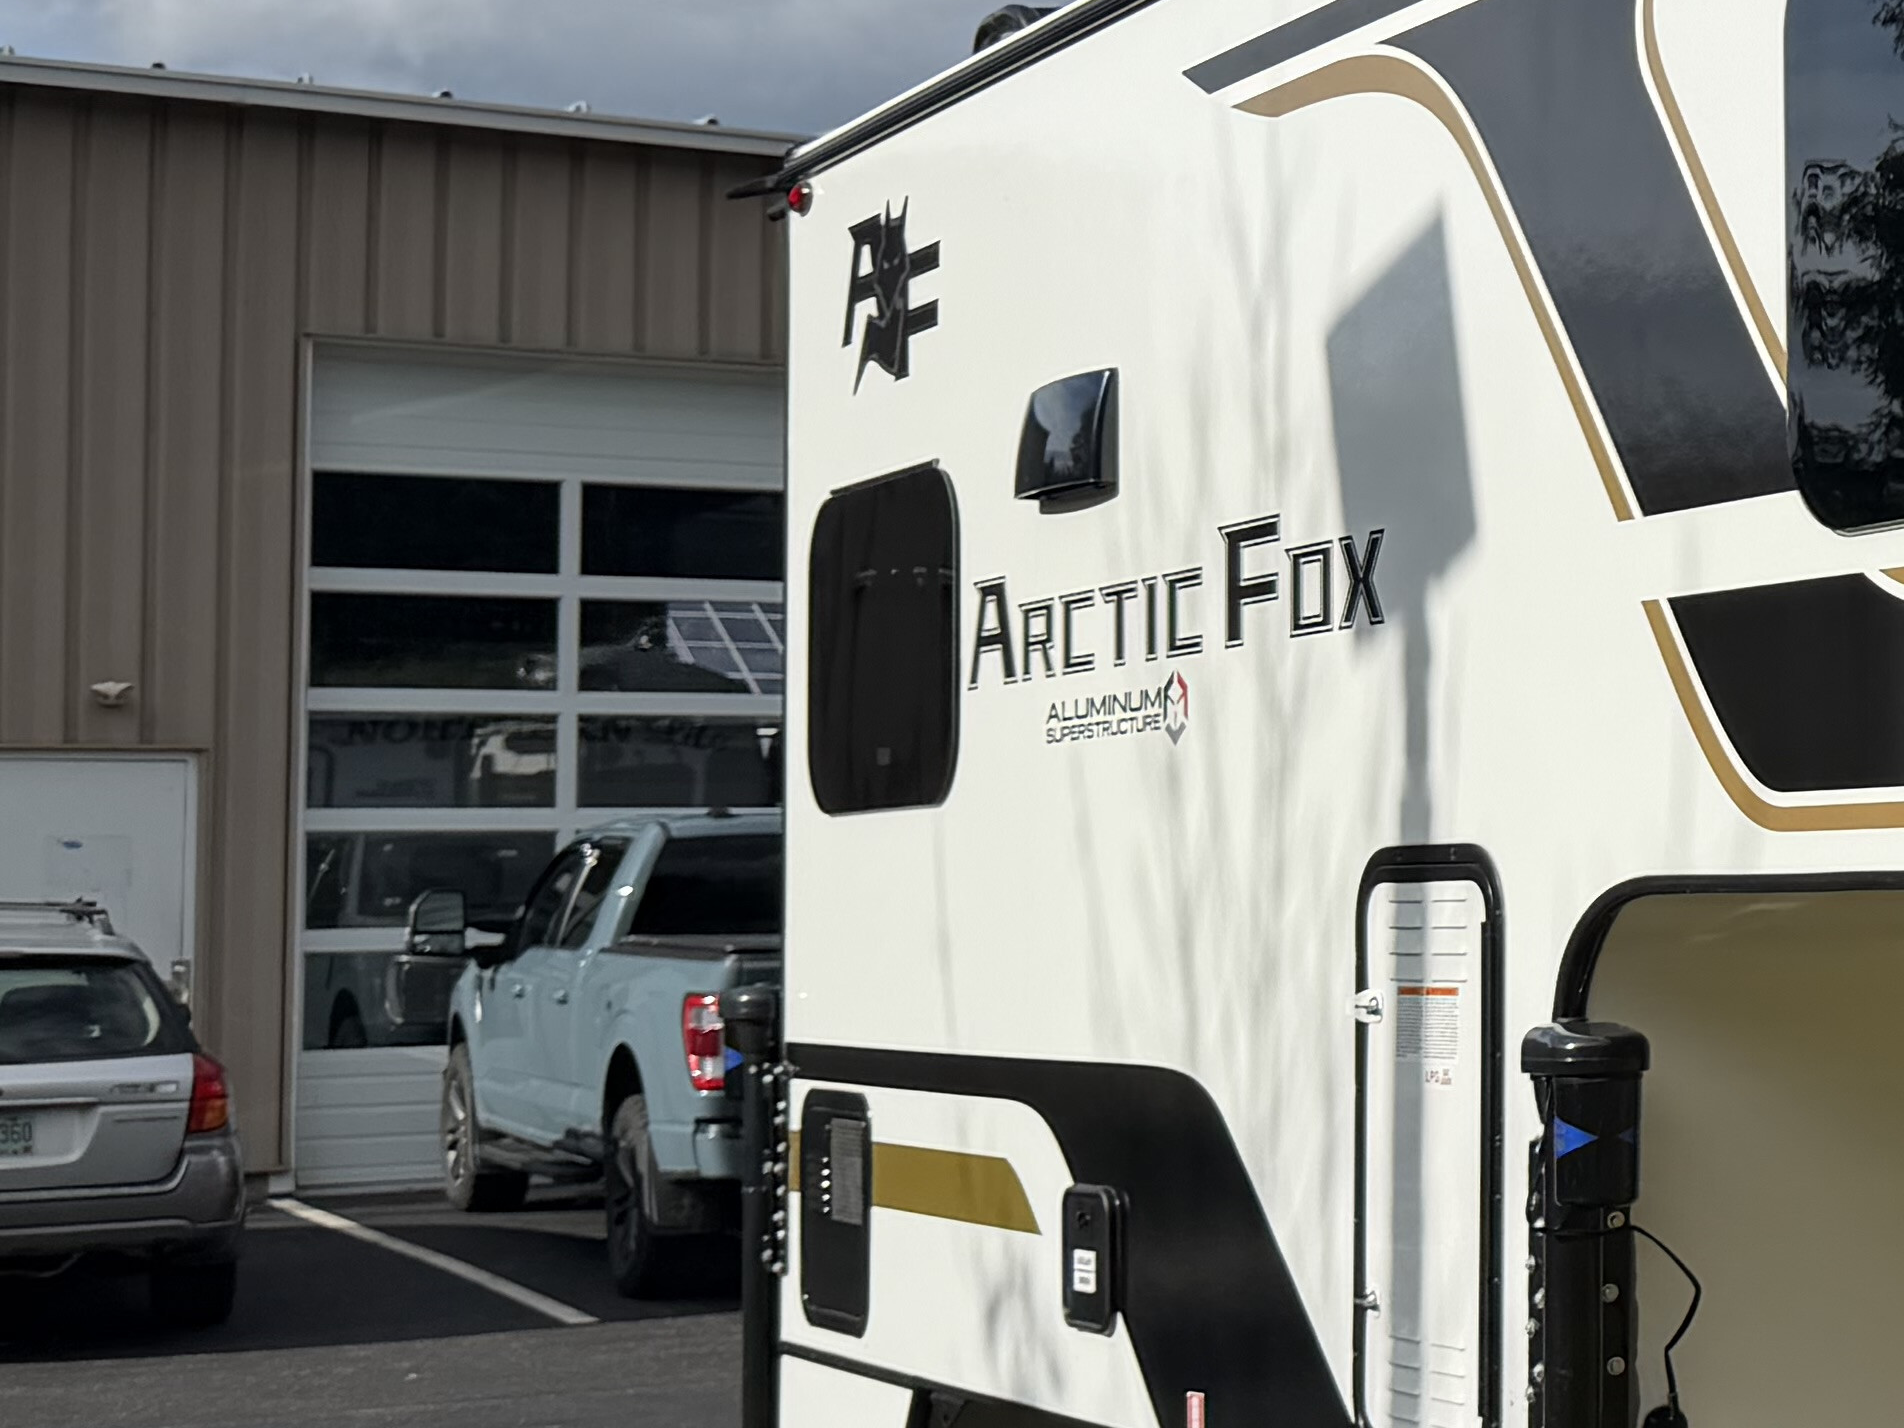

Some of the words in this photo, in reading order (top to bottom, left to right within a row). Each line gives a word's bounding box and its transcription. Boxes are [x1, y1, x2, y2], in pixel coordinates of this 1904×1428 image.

[967, 567, 1203, 690] ARCTIC
[1218, 514, 1386, 649] FOX
[1046, 687, 1163, 724] ALUMINUM
[1046, 713, 1162, 744] SUPERSTRUCTURE
